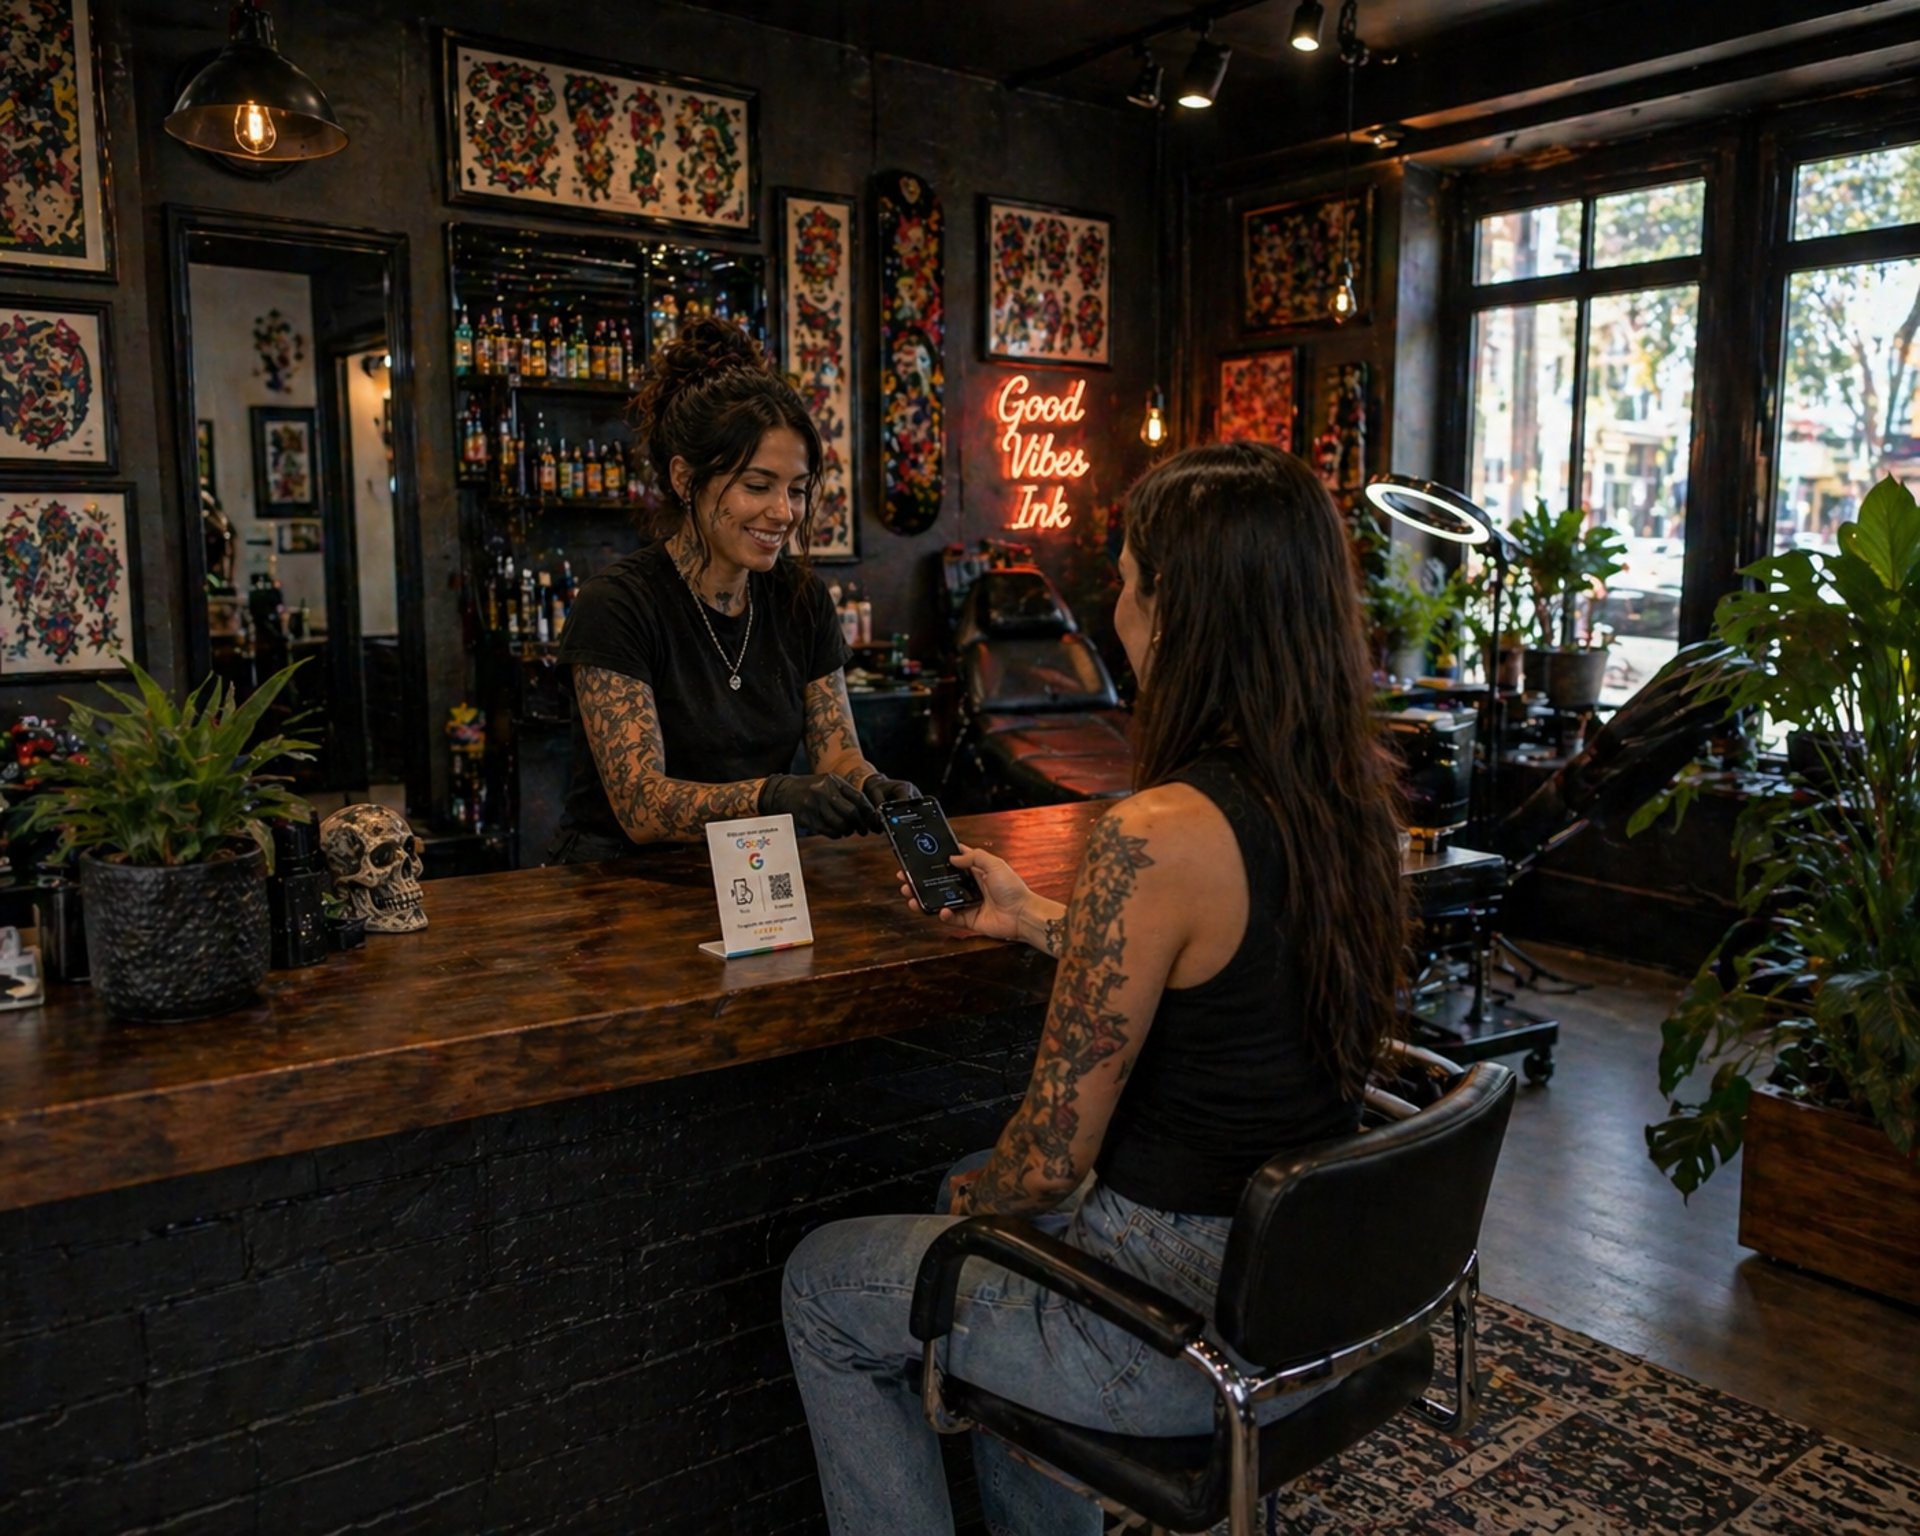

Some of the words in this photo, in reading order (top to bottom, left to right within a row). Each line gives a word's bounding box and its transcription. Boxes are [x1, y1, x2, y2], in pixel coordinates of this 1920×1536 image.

[998, 374, 1086, 430] Good
[1002, 431, 1091, 480] Vibes
[1010, 485, 1072, 530] Ink
